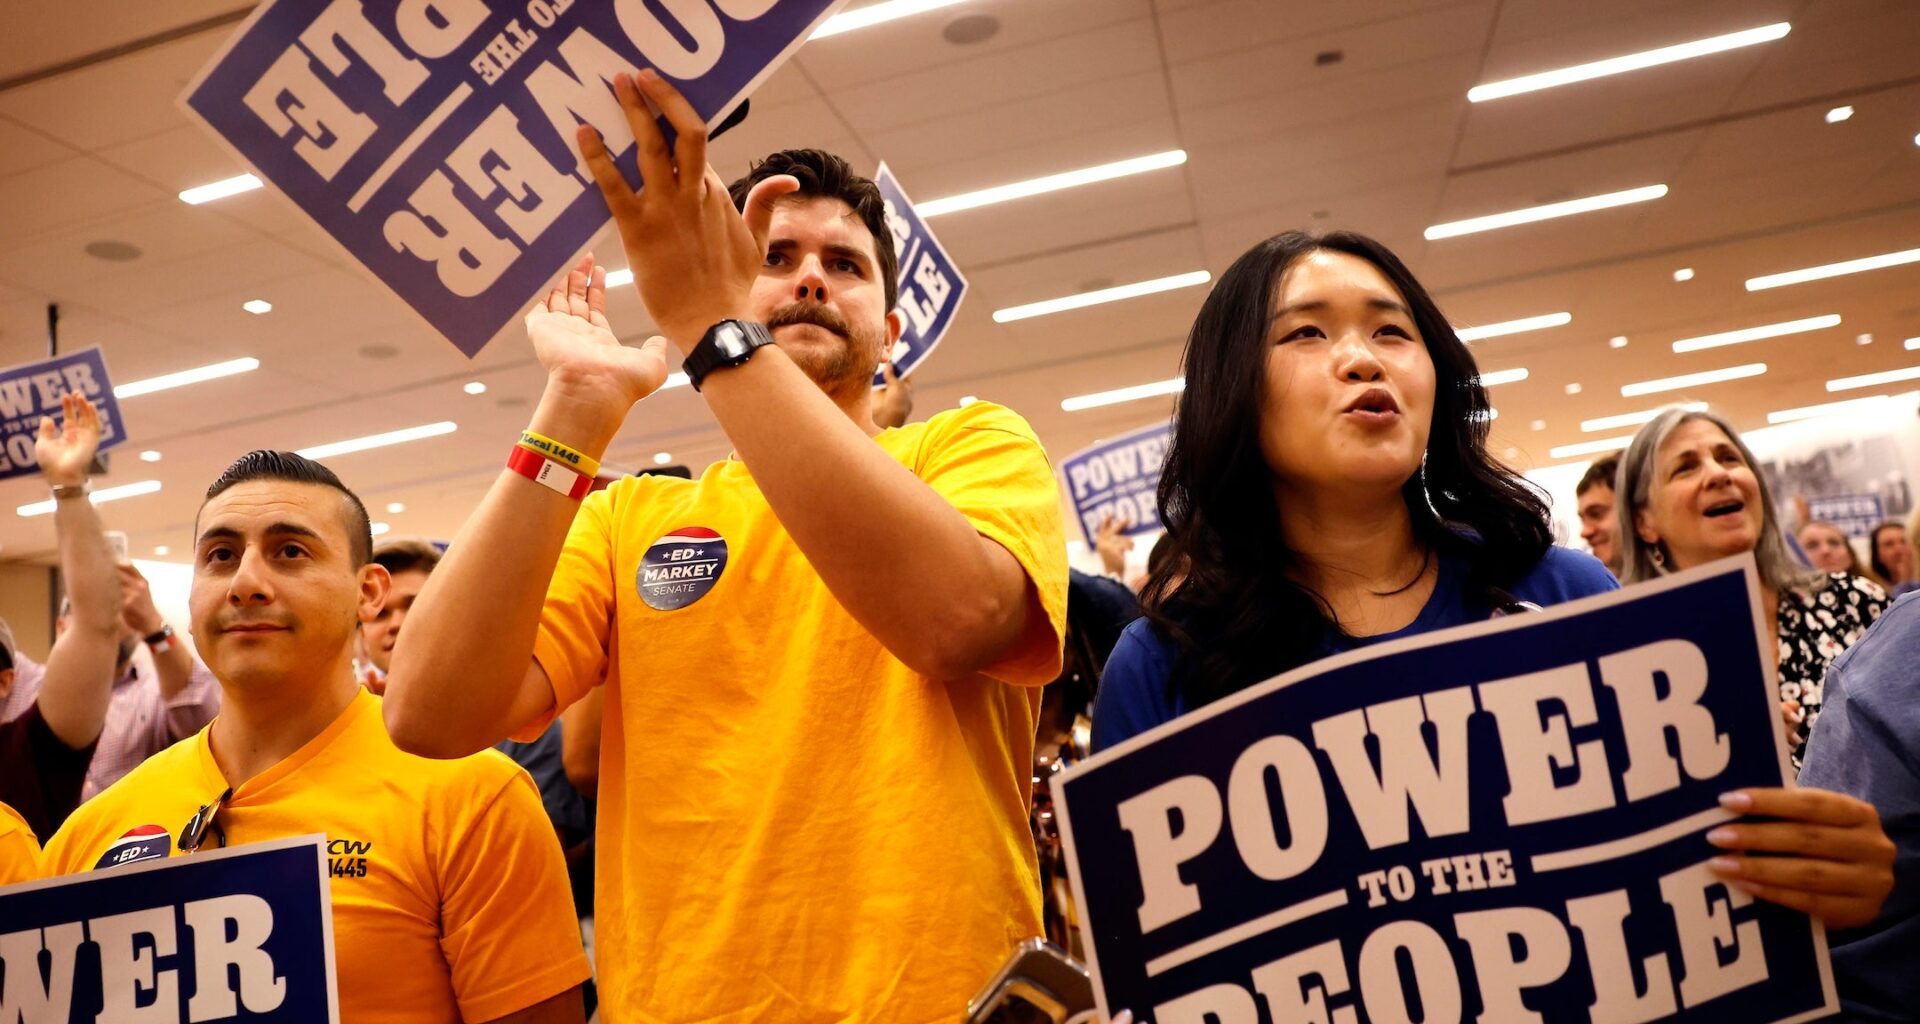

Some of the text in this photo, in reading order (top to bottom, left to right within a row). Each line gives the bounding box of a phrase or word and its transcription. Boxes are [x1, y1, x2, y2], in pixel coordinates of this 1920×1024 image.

[470, 18, 539, 86] THE
[383, 0, 780, 297] OWER
[523, 434, 580, 464] Local 1445
[671, 549, 696, 562] ED
[643, 563, 718, 582] MARKEY
[653, 583, 696, 596] SENATE
[1117, 638, 1731, 934] POWER
[119, 846, 141, 862] ED
[327, 839, 371, 855] CW
[328, 858, 367, 878] 1445
[1358, 850, 1516, 908] TO THE
[0, 894, 286, 1024] WER
